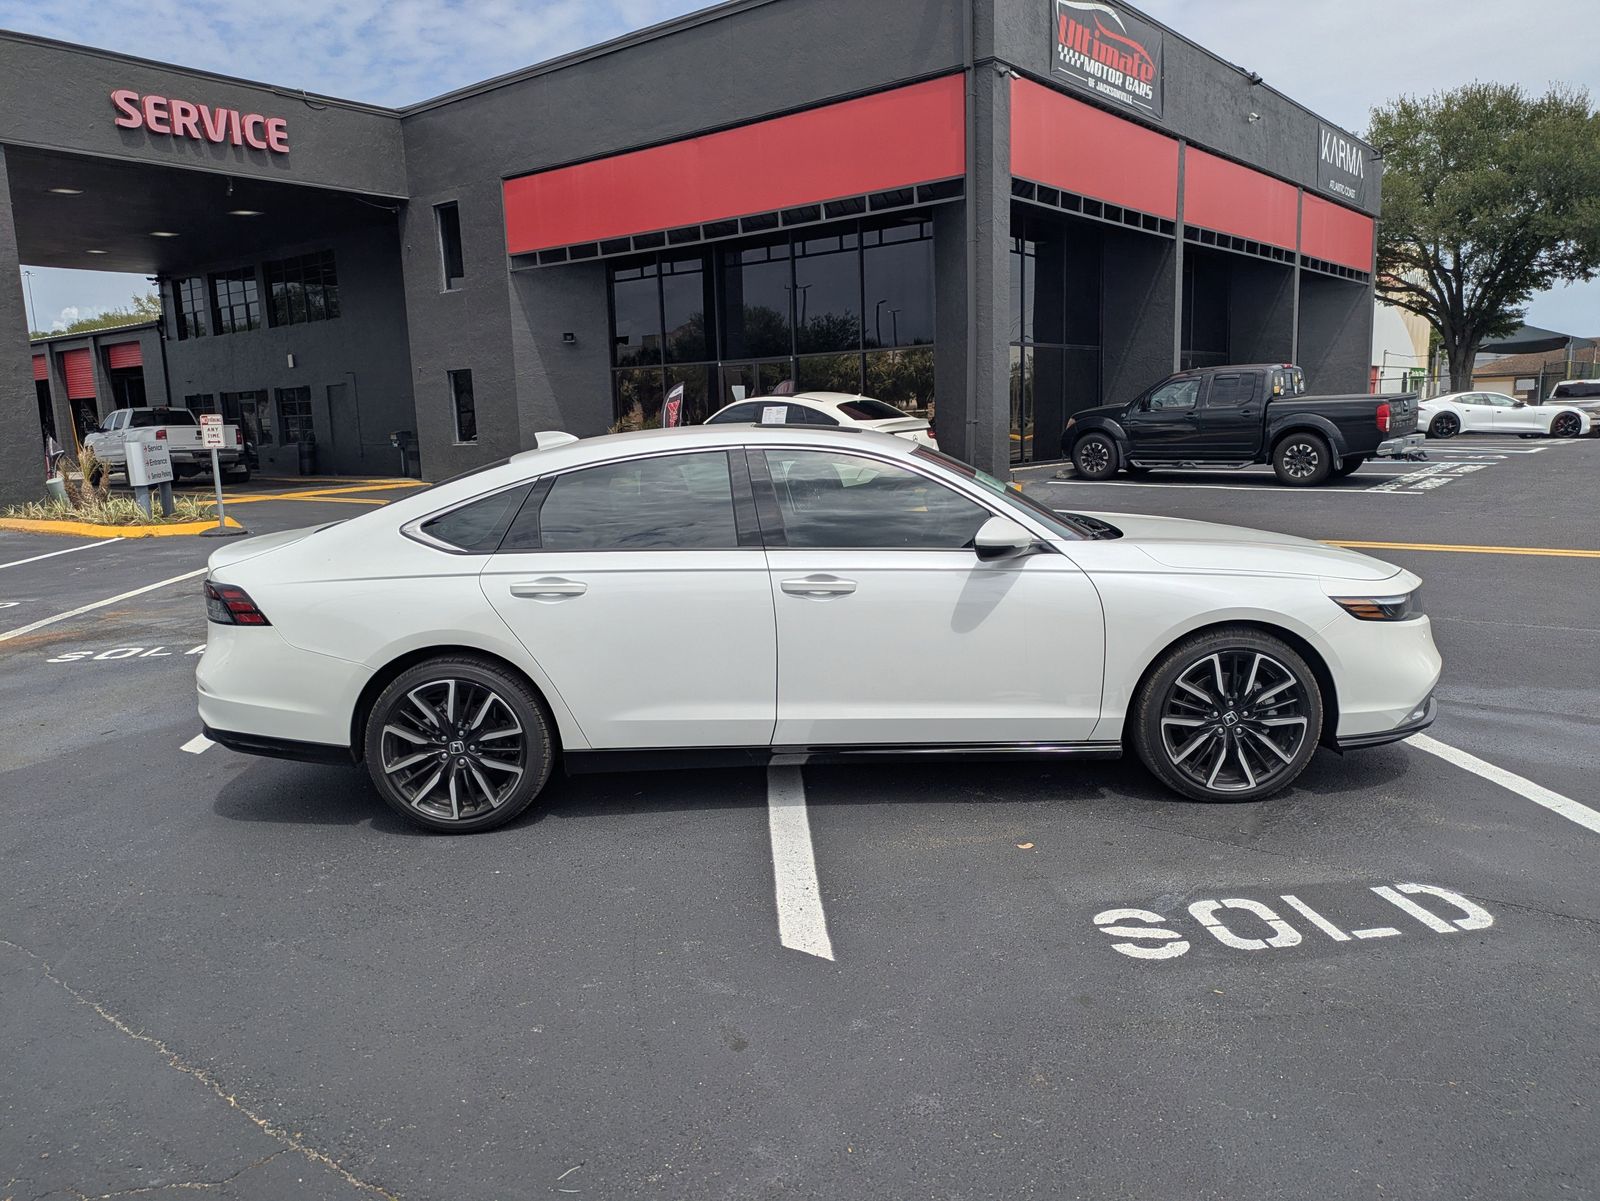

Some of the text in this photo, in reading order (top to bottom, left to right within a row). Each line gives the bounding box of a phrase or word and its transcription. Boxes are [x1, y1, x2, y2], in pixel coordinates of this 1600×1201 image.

[1059, 15, 1153, 84] Ultimate
[1083, 56, 1153, 100] MOTOR CARS
[1087, 77, 1133, 105] OF JACKSONVILLE
[111, 89, 290, 153] SERVICE
[1321, 129, 1364, 179] KARMA
[1329, 180, 1356, 199] ATLANTIC COAST
[1093, 883, 1494, 960] SOLD
